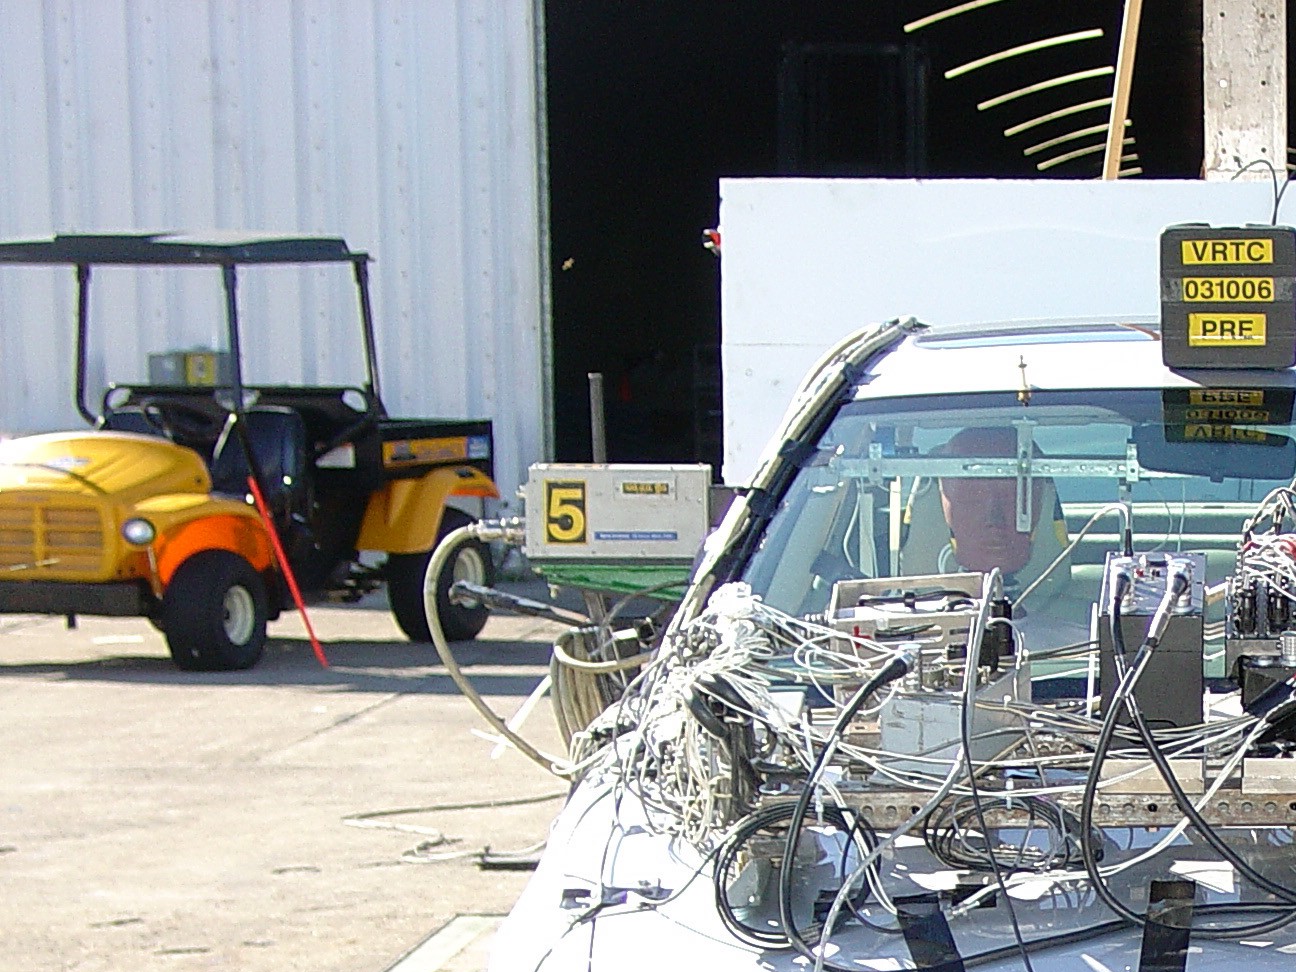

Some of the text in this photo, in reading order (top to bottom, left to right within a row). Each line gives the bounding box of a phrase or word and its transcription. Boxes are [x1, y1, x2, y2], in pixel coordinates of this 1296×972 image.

[1191, 241, 1265, 262] VRTC
[1185, 279, 1272, 299] 031006
[1202, 320, 1254, 339] PRE
[547, 487, 585, 541] 5
